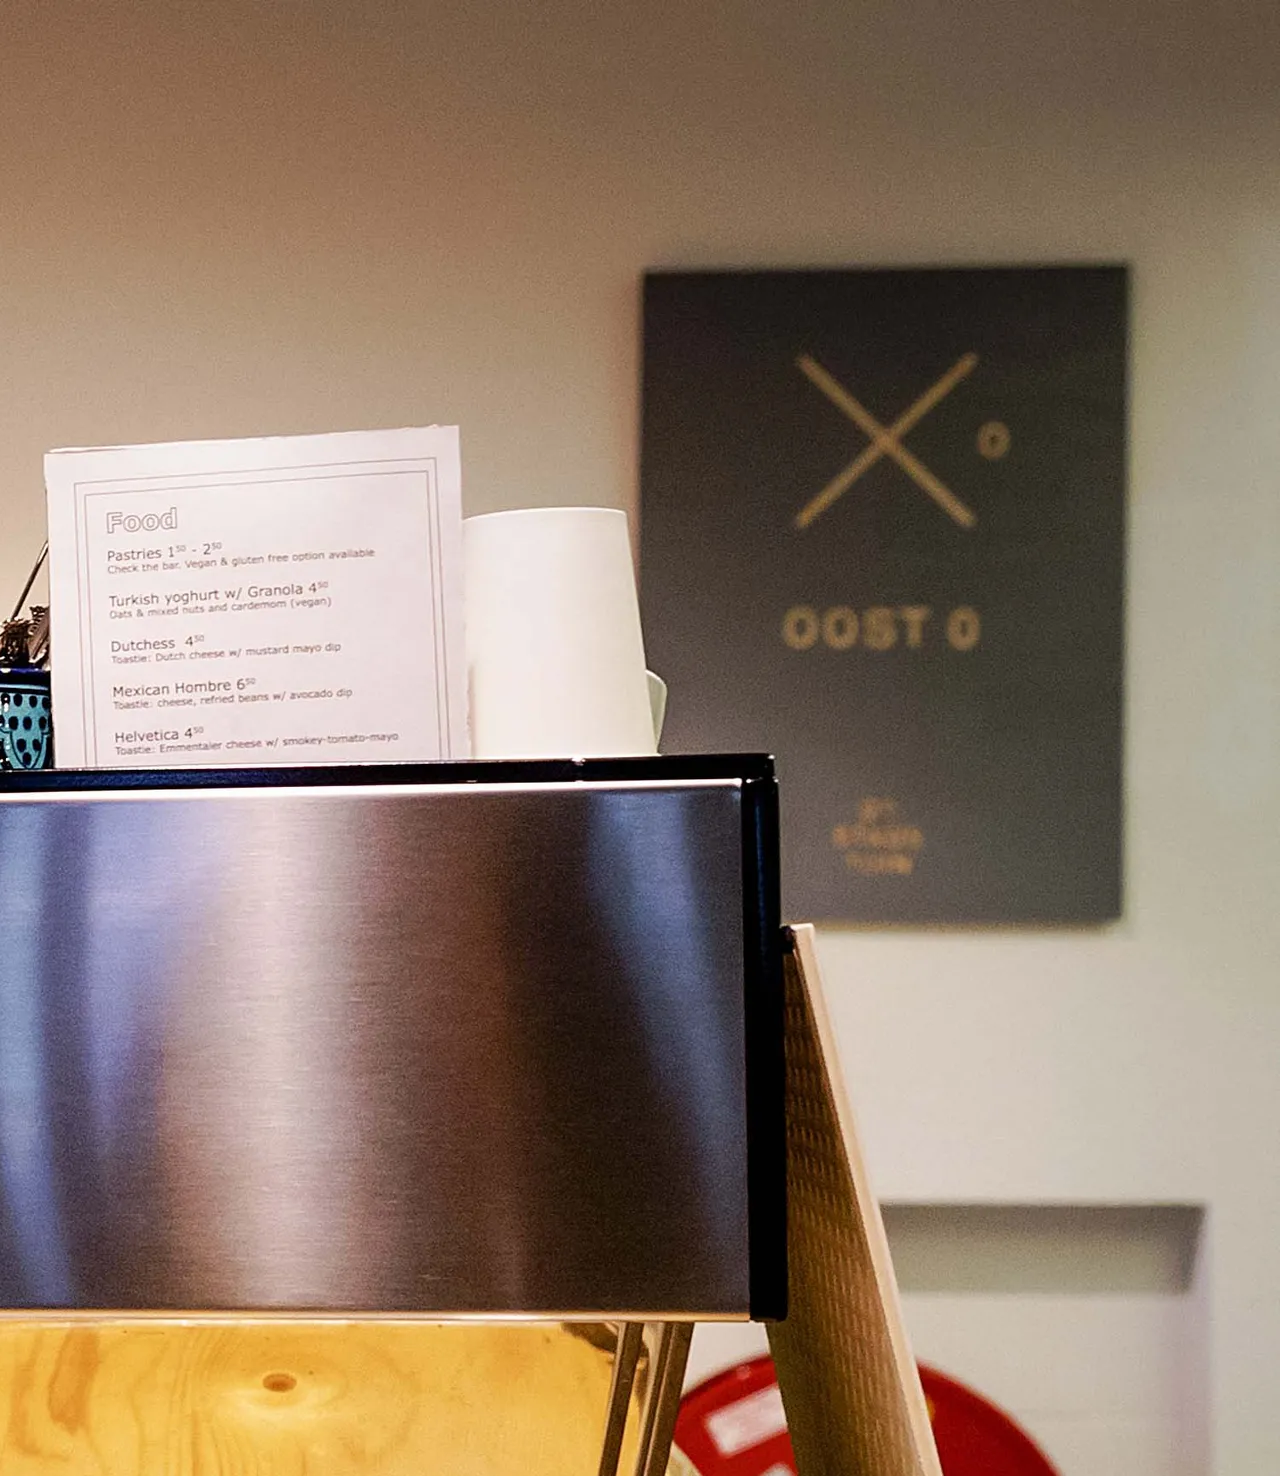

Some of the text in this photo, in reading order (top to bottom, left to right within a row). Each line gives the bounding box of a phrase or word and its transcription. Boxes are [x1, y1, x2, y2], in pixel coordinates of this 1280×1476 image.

[106, 507, 178, 534] Food
[107, 548, 162, 561] Pastries
[107, 565, 139, 574] Check
[142, 563, 159, 572] the
[185, 559, 217, 569] Vegan
[220, 557, 228, 566] &
[232, 556, 264, 567] gluten
[268, 554, 289, 563] free
[292, 551, 325, 562] option
[329, 549, 376, 559] available
[109, 593, 159, 607] Turkish
[164, 590, 219, 606] yoghurt
[224, 587, 243, 600] w/
[247, 584, 304, 598] Granola
[109, 610, 132, 619] Oats
[136, 608, 144, 617] &
[148, 607, 179, 616] mixed
[182, 605, 205, 614] nuts
[208, 603, 228, 612] and
[290, 597, 332, 608] (vegan)
[111, 639, 176, 652] Dutchess
[112, 642, 341, 664] Toastie: Dutch cheese w/ mustard mayo dip
[113, 685, 170, 697] Mexican
[175, 680, 232, 694] Hombre
[113, 687, 352, 710] Toastie: cheese, refried beans w/ avocado dip
[115, 729, 179, 743] Helvetica
[116, 732, 399, 756] Toastie: Emmentaler cheese w/ smokey-tomato-mayo
